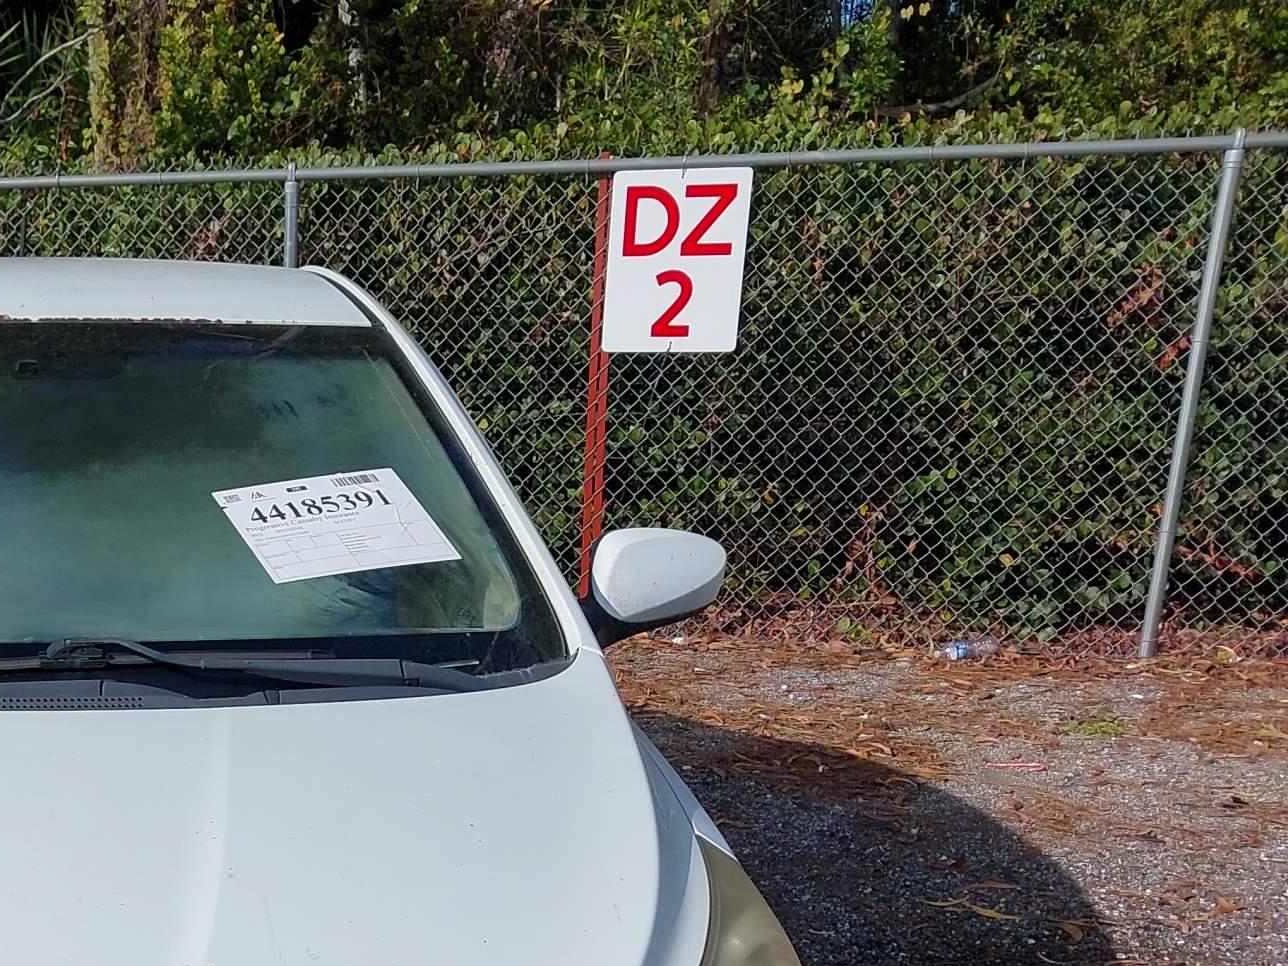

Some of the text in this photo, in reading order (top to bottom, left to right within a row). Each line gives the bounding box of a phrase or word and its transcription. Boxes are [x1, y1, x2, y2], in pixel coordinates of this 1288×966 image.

[623, 183, 738, 257] DZ
[650, 269, 693, 338] 2
[251, 489, 393, 523] 44185391
